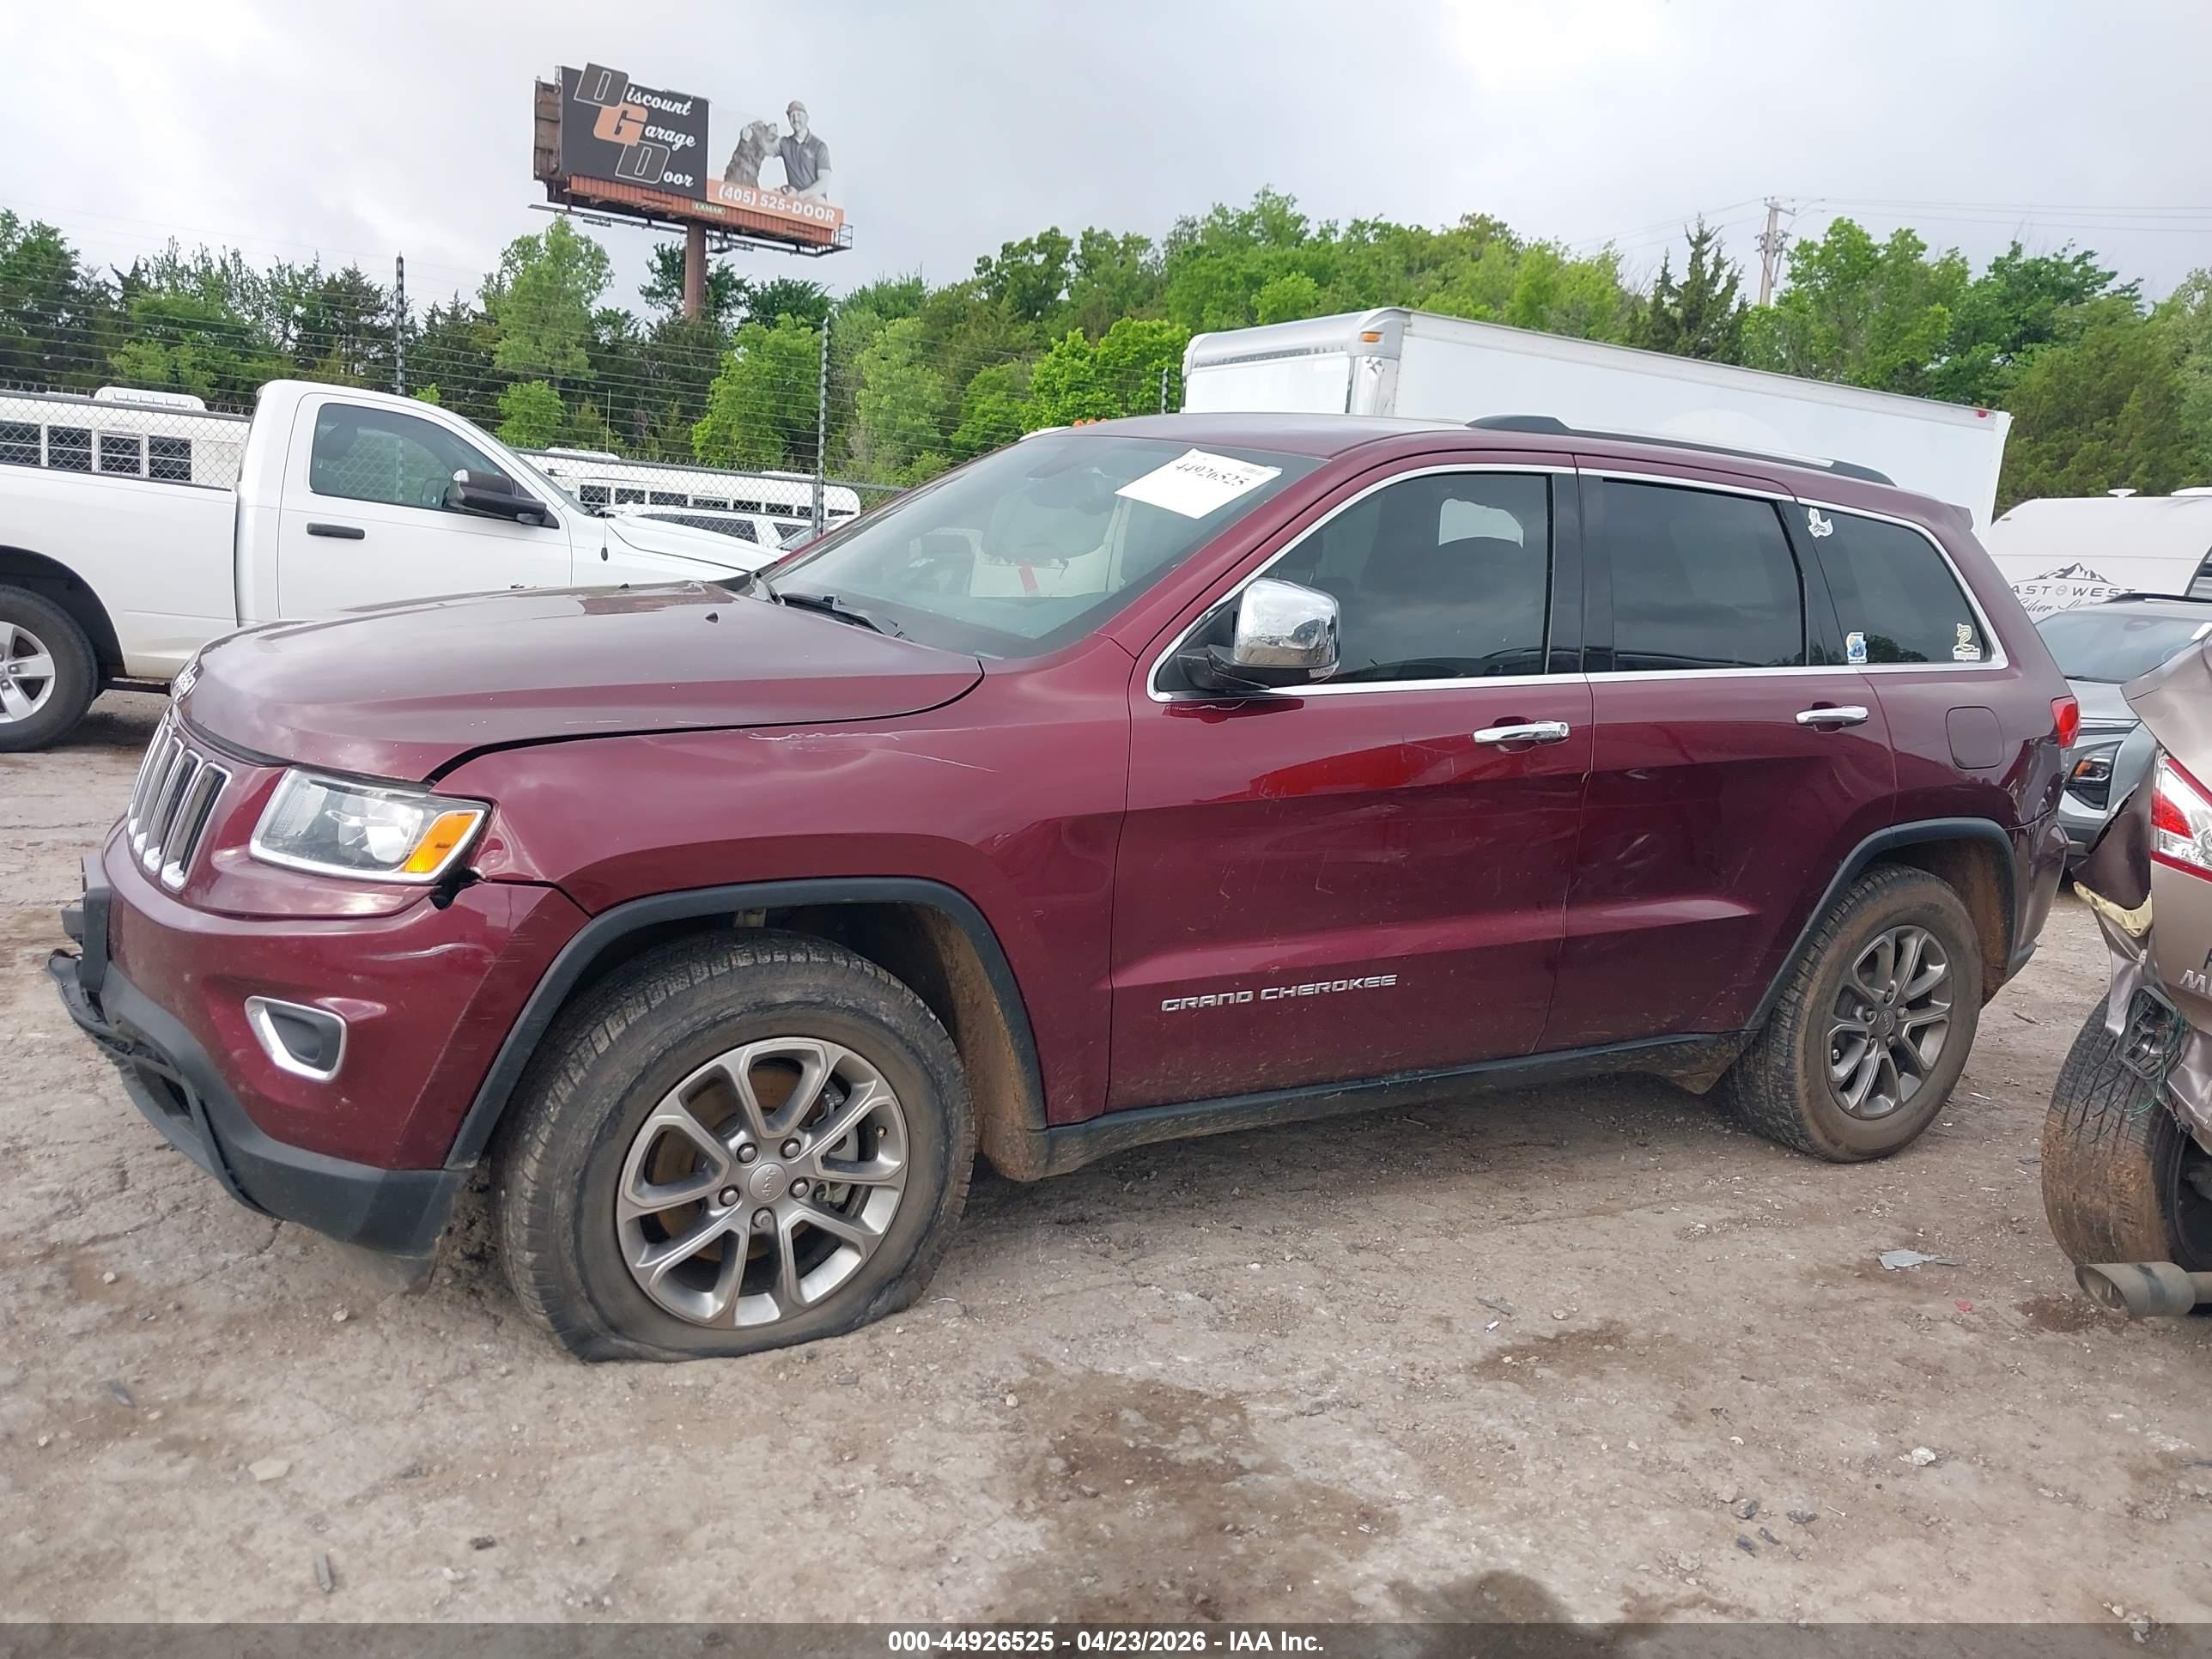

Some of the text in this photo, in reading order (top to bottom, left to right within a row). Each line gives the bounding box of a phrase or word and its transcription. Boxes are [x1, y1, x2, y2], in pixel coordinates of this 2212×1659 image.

[574, 62, 693, 116] Discount
[593, 102, 696, 151] Garage
[615, 139, 694, 187] Door
[719, 184, 836, 223] (405) 525-DOOR
[2012, 585, 2051, 595] AST
[1161, 974, 1398, 1012] GRAND CHEROKEE
